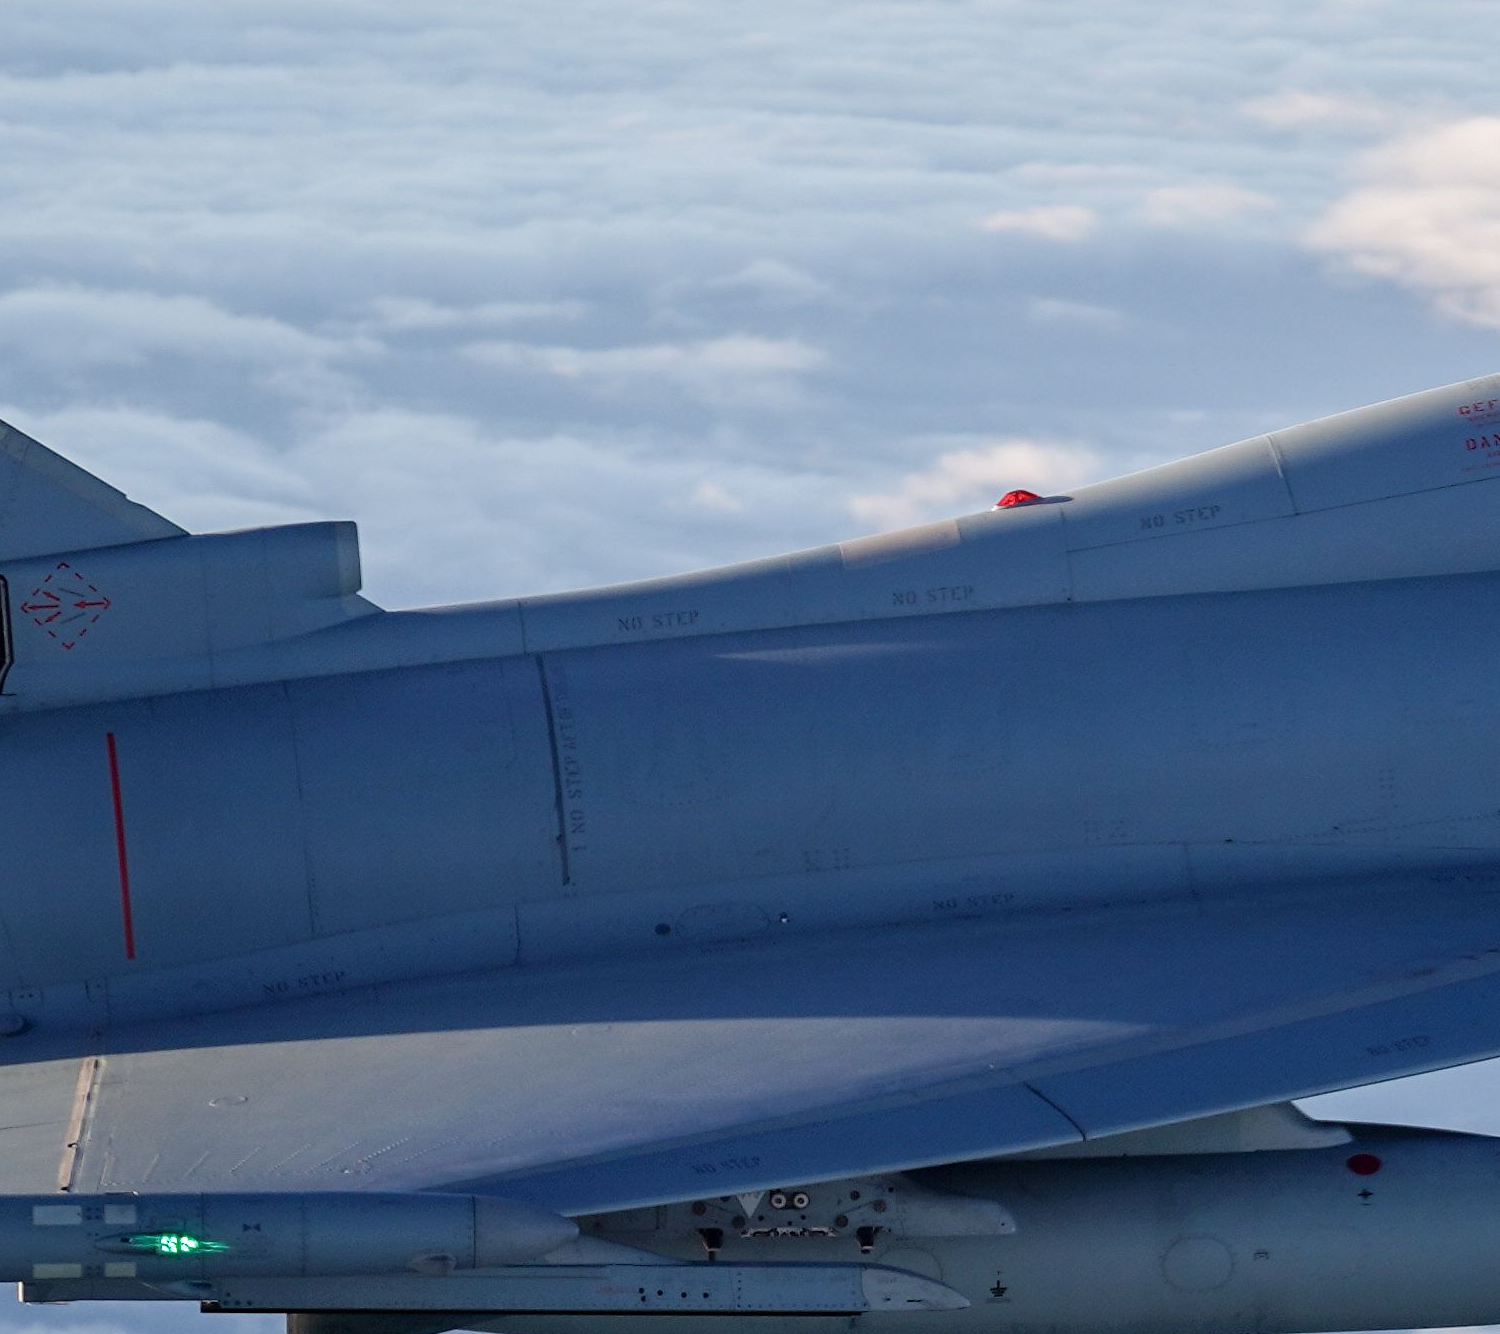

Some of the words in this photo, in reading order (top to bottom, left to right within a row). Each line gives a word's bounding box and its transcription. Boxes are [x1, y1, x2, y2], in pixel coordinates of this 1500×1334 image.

[1140, 514, 1165, 530] NO
[1173, 505, 1221, 524] STEP
[892, 591, 917, 606] NO
[927, 585, 974, 603] STEP
[618, 616, 642, 632] NO
[652, 610, 699, 627] STEP
[262, 981, 289, 995] NO
[298, 971, 345, 988] STEP
